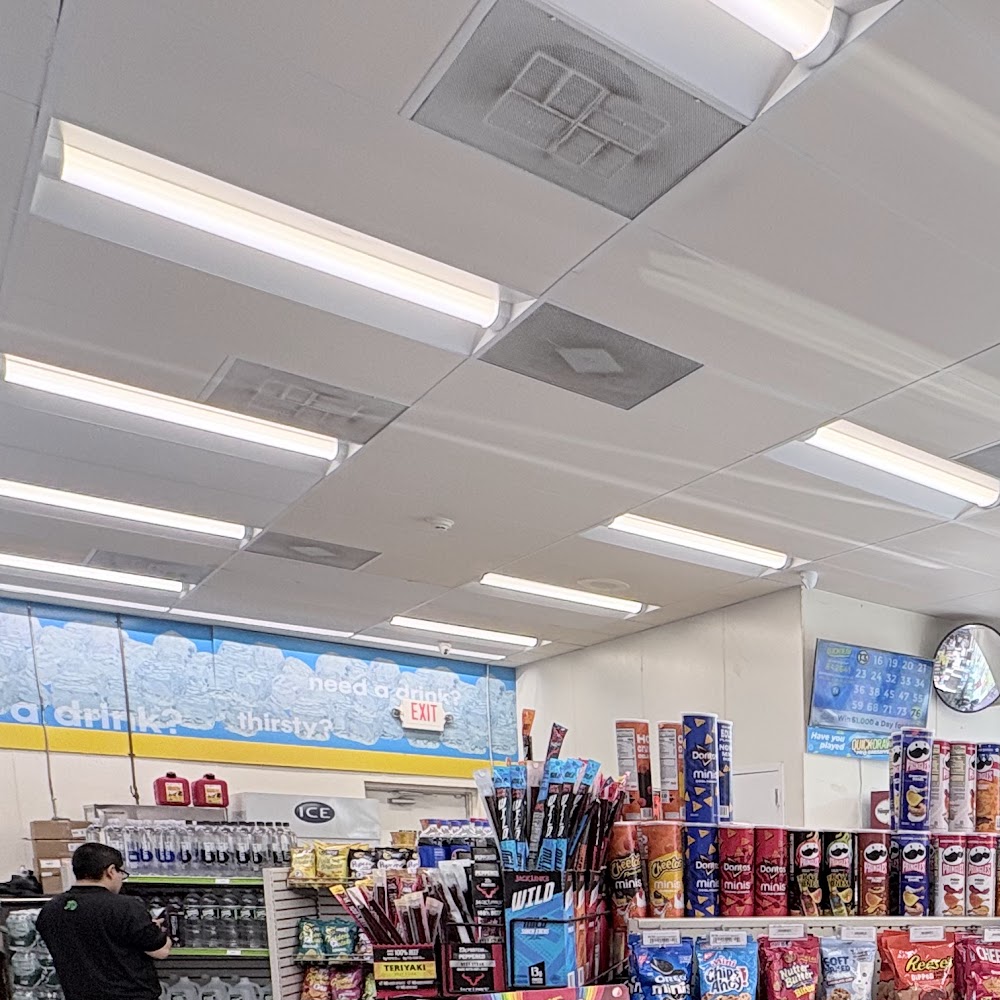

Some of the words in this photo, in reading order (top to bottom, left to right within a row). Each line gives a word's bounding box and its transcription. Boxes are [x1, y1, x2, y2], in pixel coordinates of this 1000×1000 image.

[873, 655, 884, 666] 16
[888, 659, 898, 669] 19
[902, 660, 914, 671] 20
[855, 668, 867, 679] 23
[870, 671, 882, 681] 24
[886, 673, 897, 684] 32
[900, 675, 912, 686] 33
[914, 678, 925, 688] 34
[309, 676, 367, 697] need
[375, 685, 390, 699] a
[853, 684, 865, 695] 36
[868, 686, 880, 697] 38
[883, 688, 895, 699] 45
[898, 690, 910, 701] 47
[411, 703, 438, 723] EXIT
[852, 701, 863, 711] 59
[866, 702, 879, 713] 68
[896, 706, 907, 716] 73
[911, 708, 921, 718] 76
[11, 702, 43, 725] a
[54, 701, 182, 735] drink?
[880, 720, 894, 730] Day
[238, 711, 334, 742] thirsty?
[811, 732, 829, 741] Have
[830, 734, 846, 744] you
[819, 741, 846, 751] played
[299, 805, 331, 819] ICE
[723, 862, 751, 872] Doritos
[760, 864, 786, 874] Doritos
[615, 879, 642, 889] minis
[724, 881, 750, 890] minis
[760, 882, 786, 892] minis
[511, 881, 556, 912] WILD
[384, 964, 426, 972] TERIYAKI
[713, 959, 736, 967] Mini
[825, 957, 849, 967] SOFT
[706, 967, 740, 983] Chips
[780, 963, 811, 980] Nutter
[783, 972, 815, 988] Butter
[652, 981, 690, 995] minis
